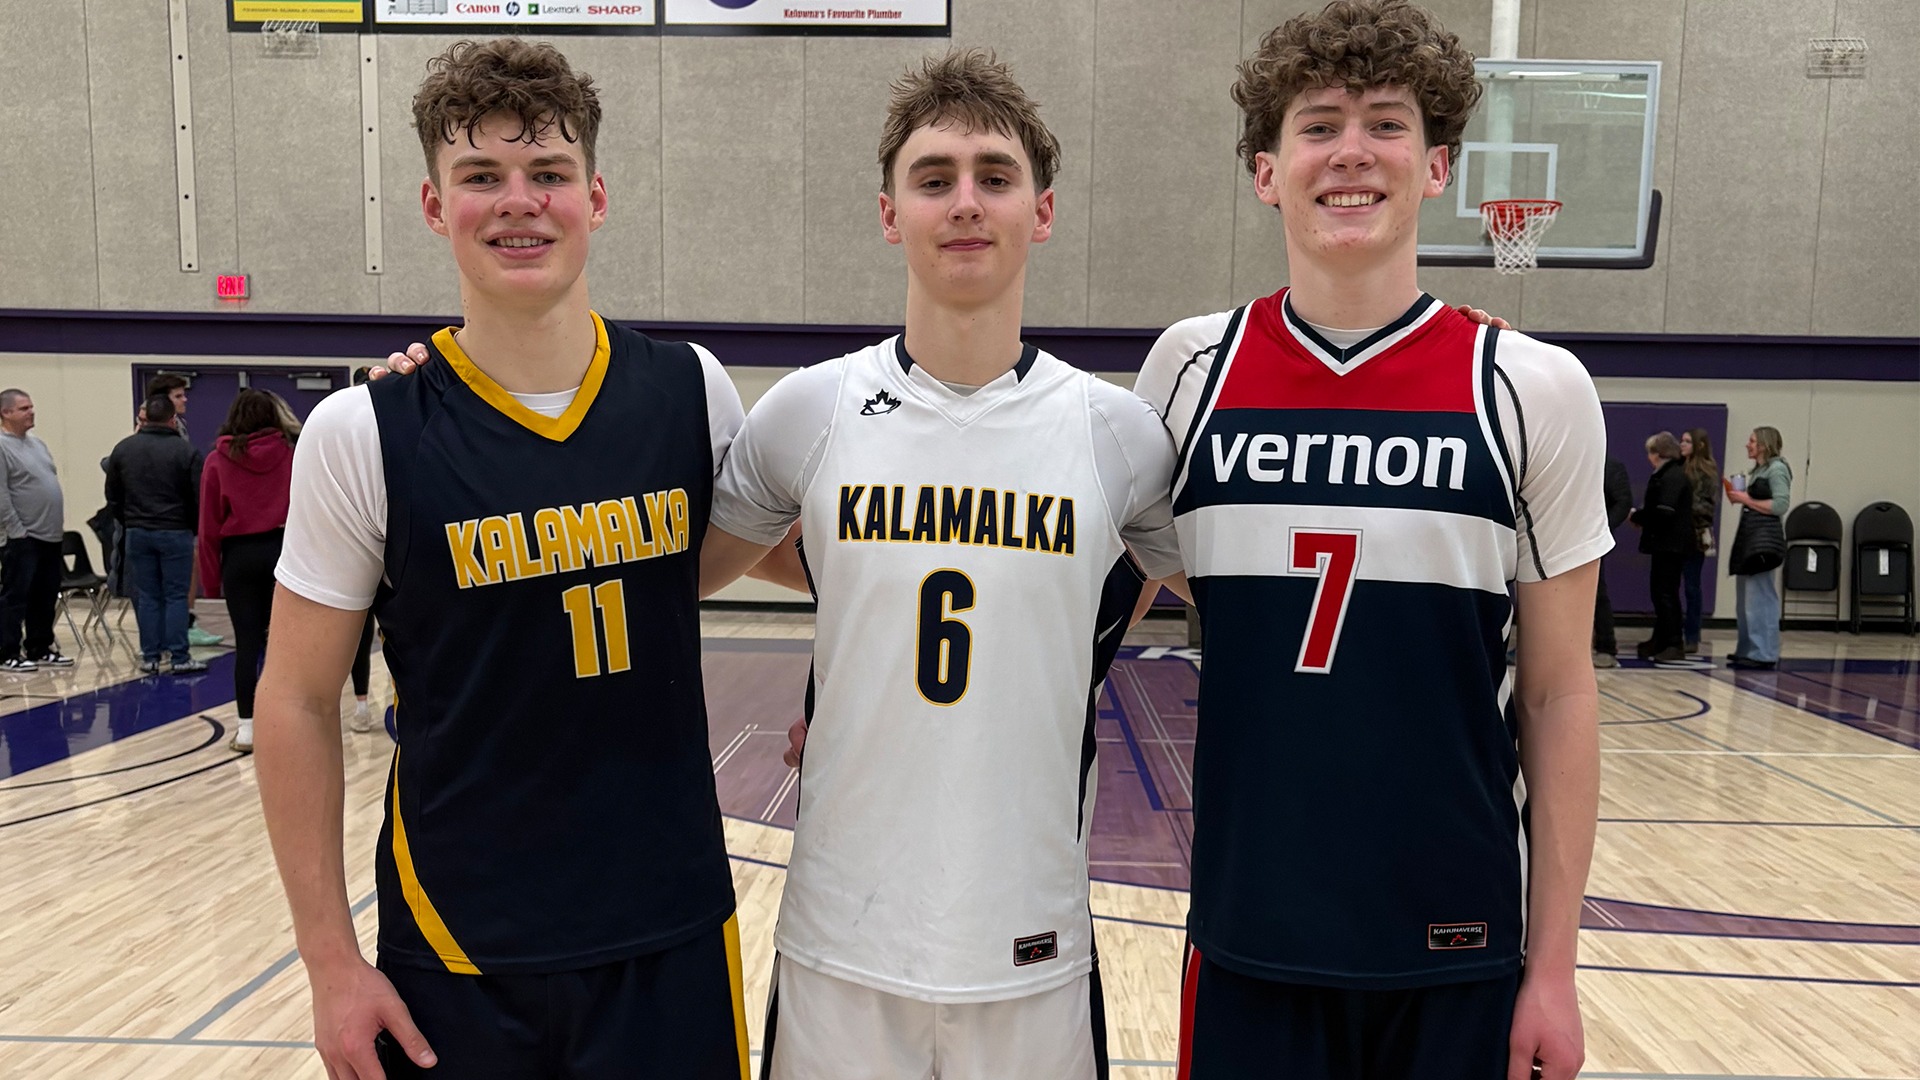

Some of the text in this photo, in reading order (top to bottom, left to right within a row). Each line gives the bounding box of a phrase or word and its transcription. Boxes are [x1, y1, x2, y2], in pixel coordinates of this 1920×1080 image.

[456, 3, 499, 14] Canon
[542, 5, 580, 14] Lexmark
[587, 5, 642, 15] SHARP
[783, 9, 902, 19] Kelowna's Favourite Plumber
[1211, 433, 1467, 490] vernon
[445, 488, 689, 589] KALAMALKA
[838, 484, 1076, 557] KALAMALKA
[562, 578, 631, 679] 11
[1287, 526, 1363, 674] 7
[915, 567, 977, 707] 6
[1433, 926, 1483, 935] KAHUNAVERSE
